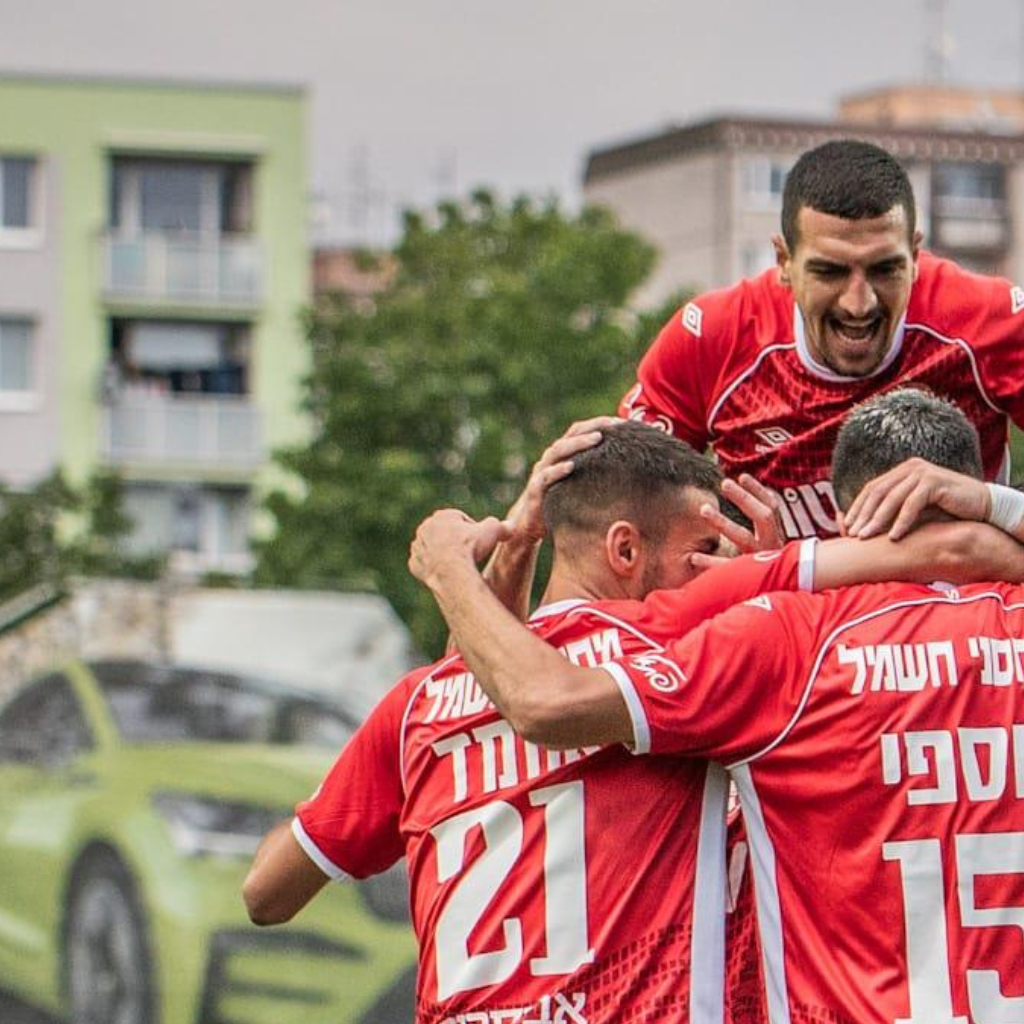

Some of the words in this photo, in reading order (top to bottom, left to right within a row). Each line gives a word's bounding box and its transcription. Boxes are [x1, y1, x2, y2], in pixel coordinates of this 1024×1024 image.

[837, 644, 958, 695] חשמל
[425, 672, 496, 724] שמל
[430, 780, 596, 1002] 21
